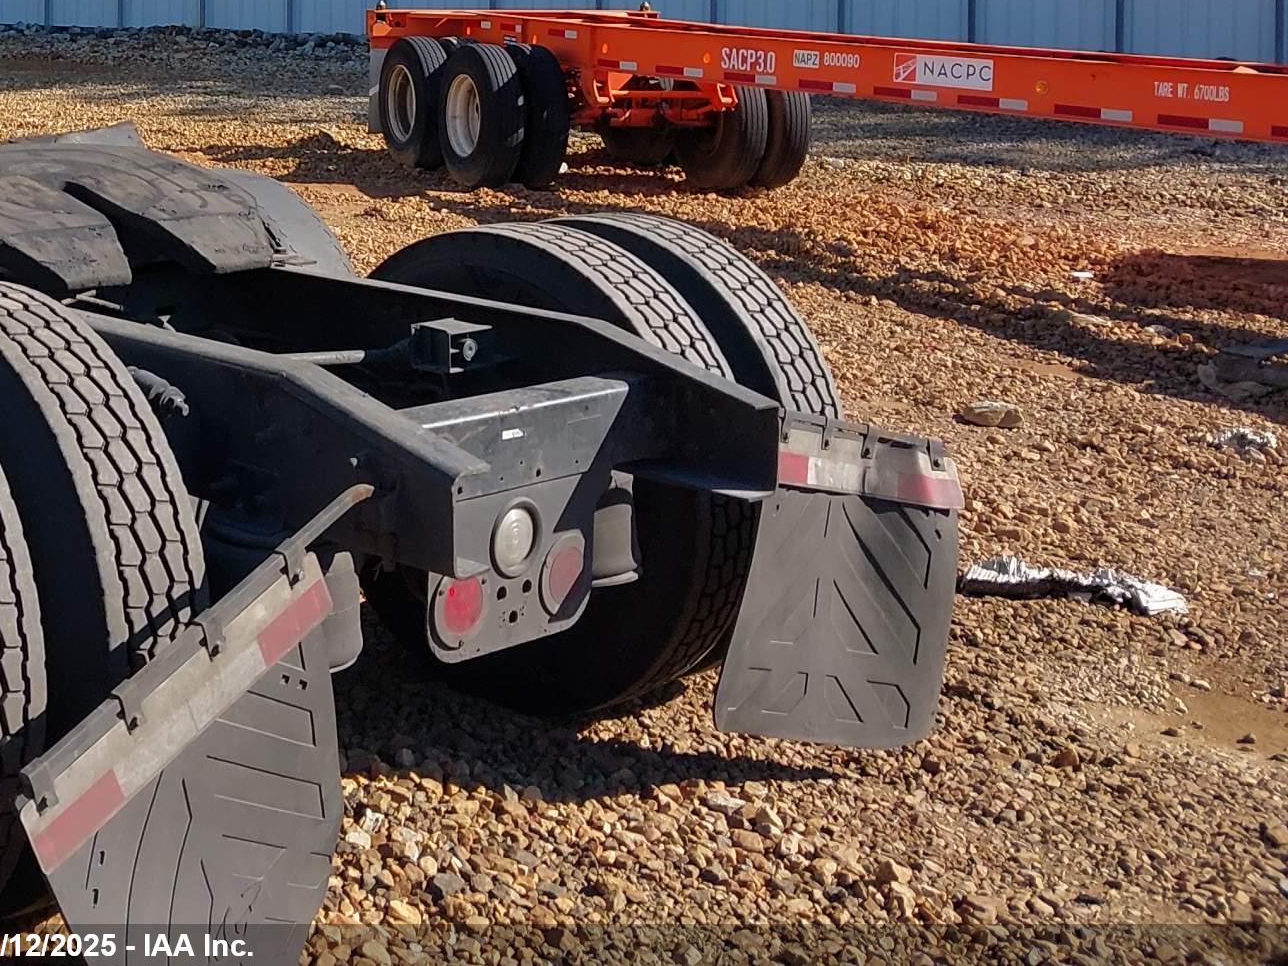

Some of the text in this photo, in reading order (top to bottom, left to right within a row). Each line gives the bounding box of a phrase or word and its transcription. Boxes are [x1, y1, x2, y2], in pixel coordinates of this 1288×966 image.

[721, 47, 860, 73] SACP3.0 NAPZ 800090
[923, 61, 992, 82] NACPC
[1154, 81, 1174, 98] TARE
